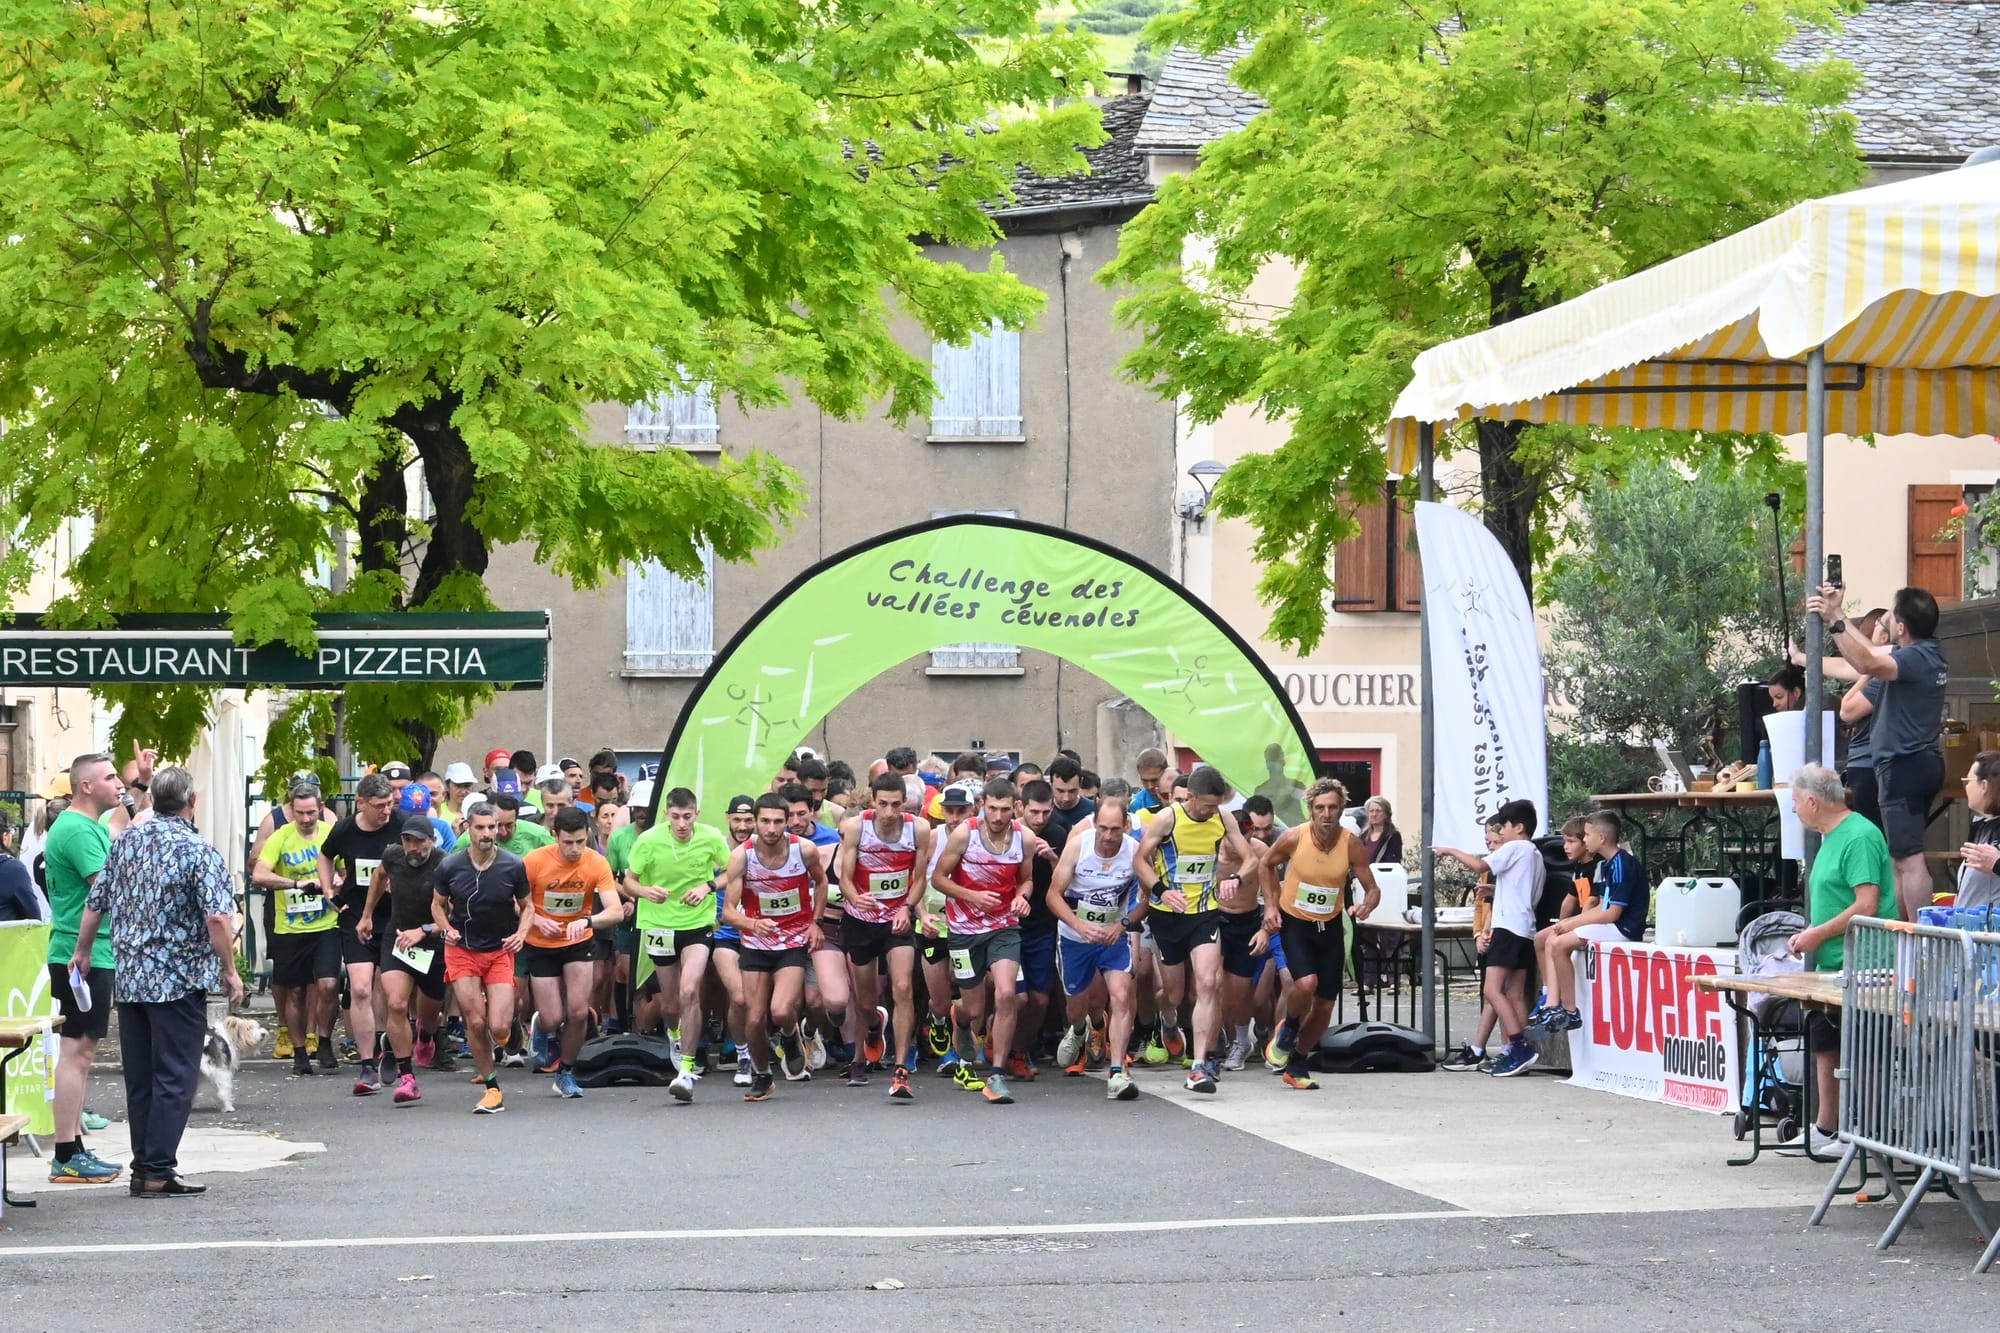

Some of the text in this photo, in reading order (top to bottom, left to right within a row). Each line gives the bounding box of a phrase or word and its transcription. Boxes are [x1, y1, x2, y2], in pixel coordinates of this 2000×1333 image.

[889, 560, 1123, 603] Challenge des
[867, 591, 1140, 628] vallées cévenoles
[3, 647, 487, 676] RESTAURANT PIZZERIA
[1283, 673, 1421, 706] OUCHER
[283, 845, 319, 867] RUN
[1186, 862, 1206, 874] 47
[880, 879, 900, 891] 60
[290, 893, 316, 904] 119
[554, 898, 573, 908] 76
[770, 897, 790, 910] 83
[1307, 892, 1327, 905] 89
[1086, 911, 1106, 923] 64
[647, 934, 664, 948] 74
[951, 957, 963, 970] 5
[1664, 1036, 1726, 1082] nouvelle
